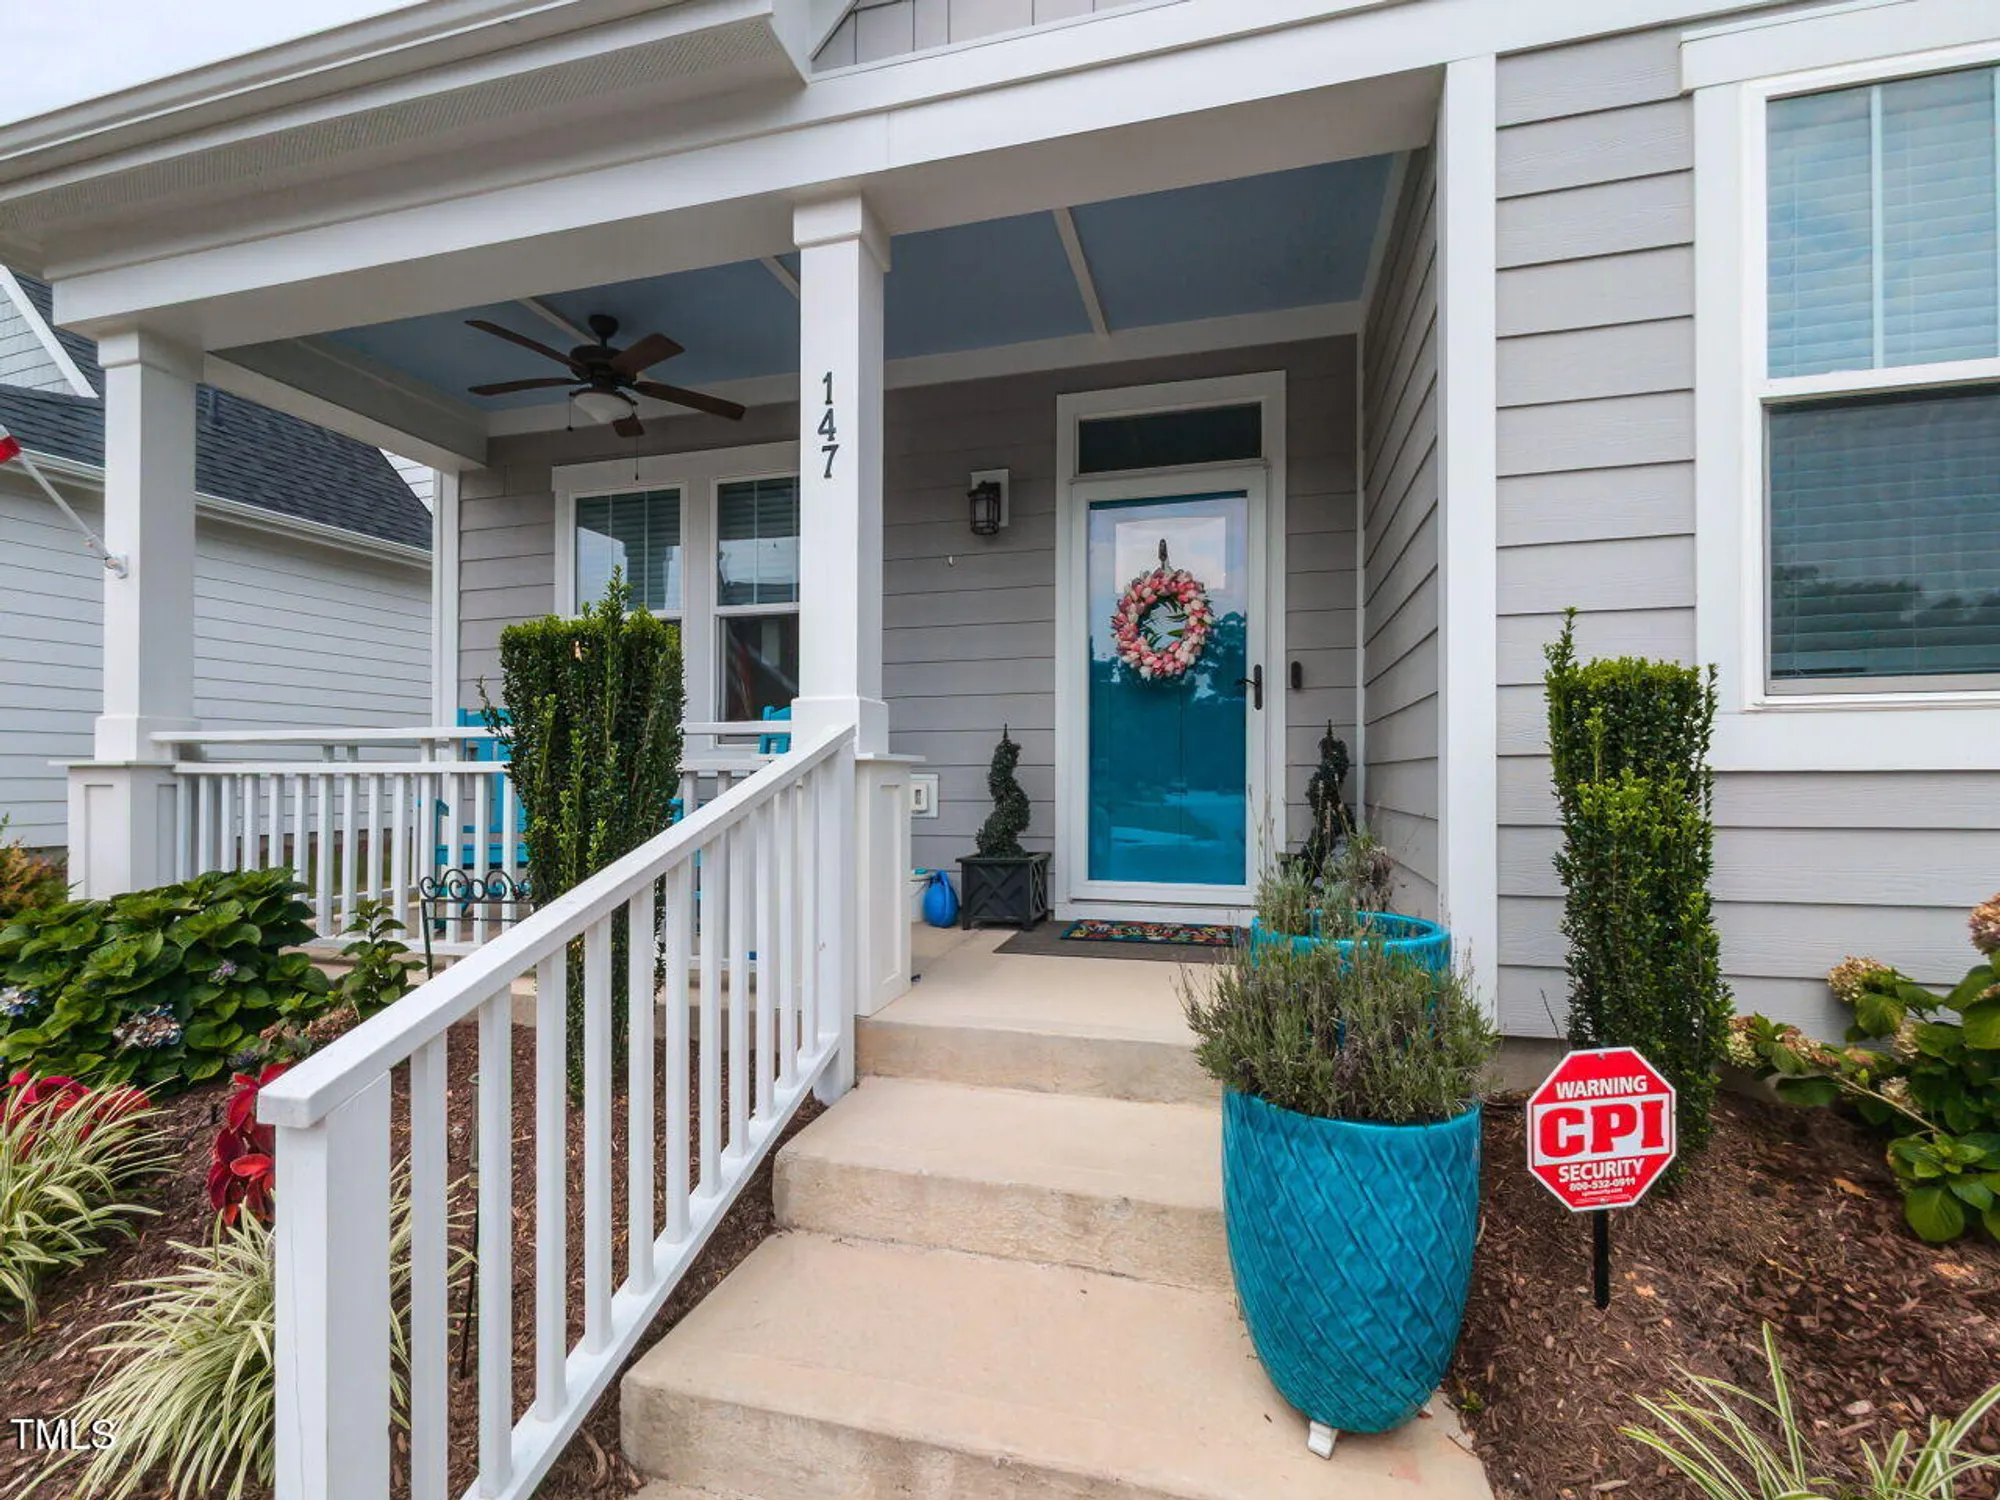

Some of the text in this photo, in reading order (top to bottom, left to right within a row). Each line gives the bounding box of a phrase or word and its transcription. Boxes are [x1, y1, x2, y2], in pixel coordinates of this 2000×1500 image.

[817, 371, 839, 479] 147
[1556, 1075, 1648, 1099] WARNING
[1539, 1100, 1664, 1158] CPI
[1558, 1158, 1645, 1183] SECURITY
